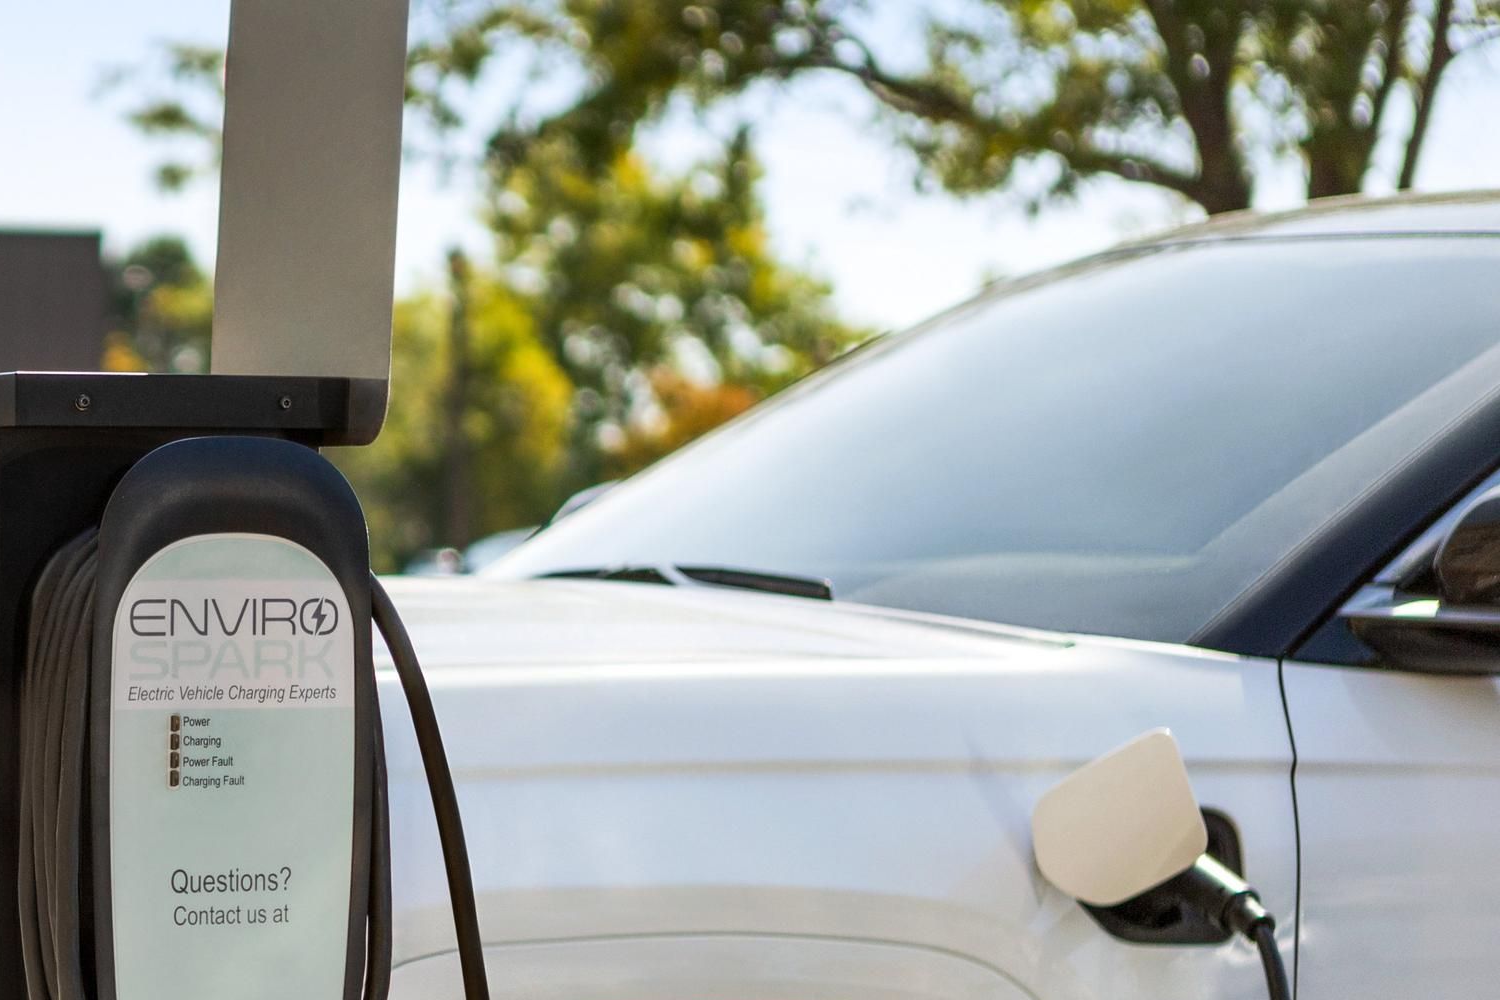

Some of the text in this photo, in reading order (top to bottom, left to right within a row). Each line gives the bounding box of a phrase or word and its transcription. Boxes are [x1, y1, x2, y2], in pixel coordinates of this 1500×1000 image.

[129, 597, 339, 637] ENVIRO
[128, 639, 335, 682] SPARK
[128, 684, 337, 703] Electric Vehicle Charging Experts
[183, 716, 211, 727] Power
[183, 735, 222, 748] Charging
[183, 756, 234, 767] Power Fault
[182, 775, 245, 788] Charging Fault
[171, 866, 292, 894] Questions?
[173, 904, 289, 926] Contact us at
